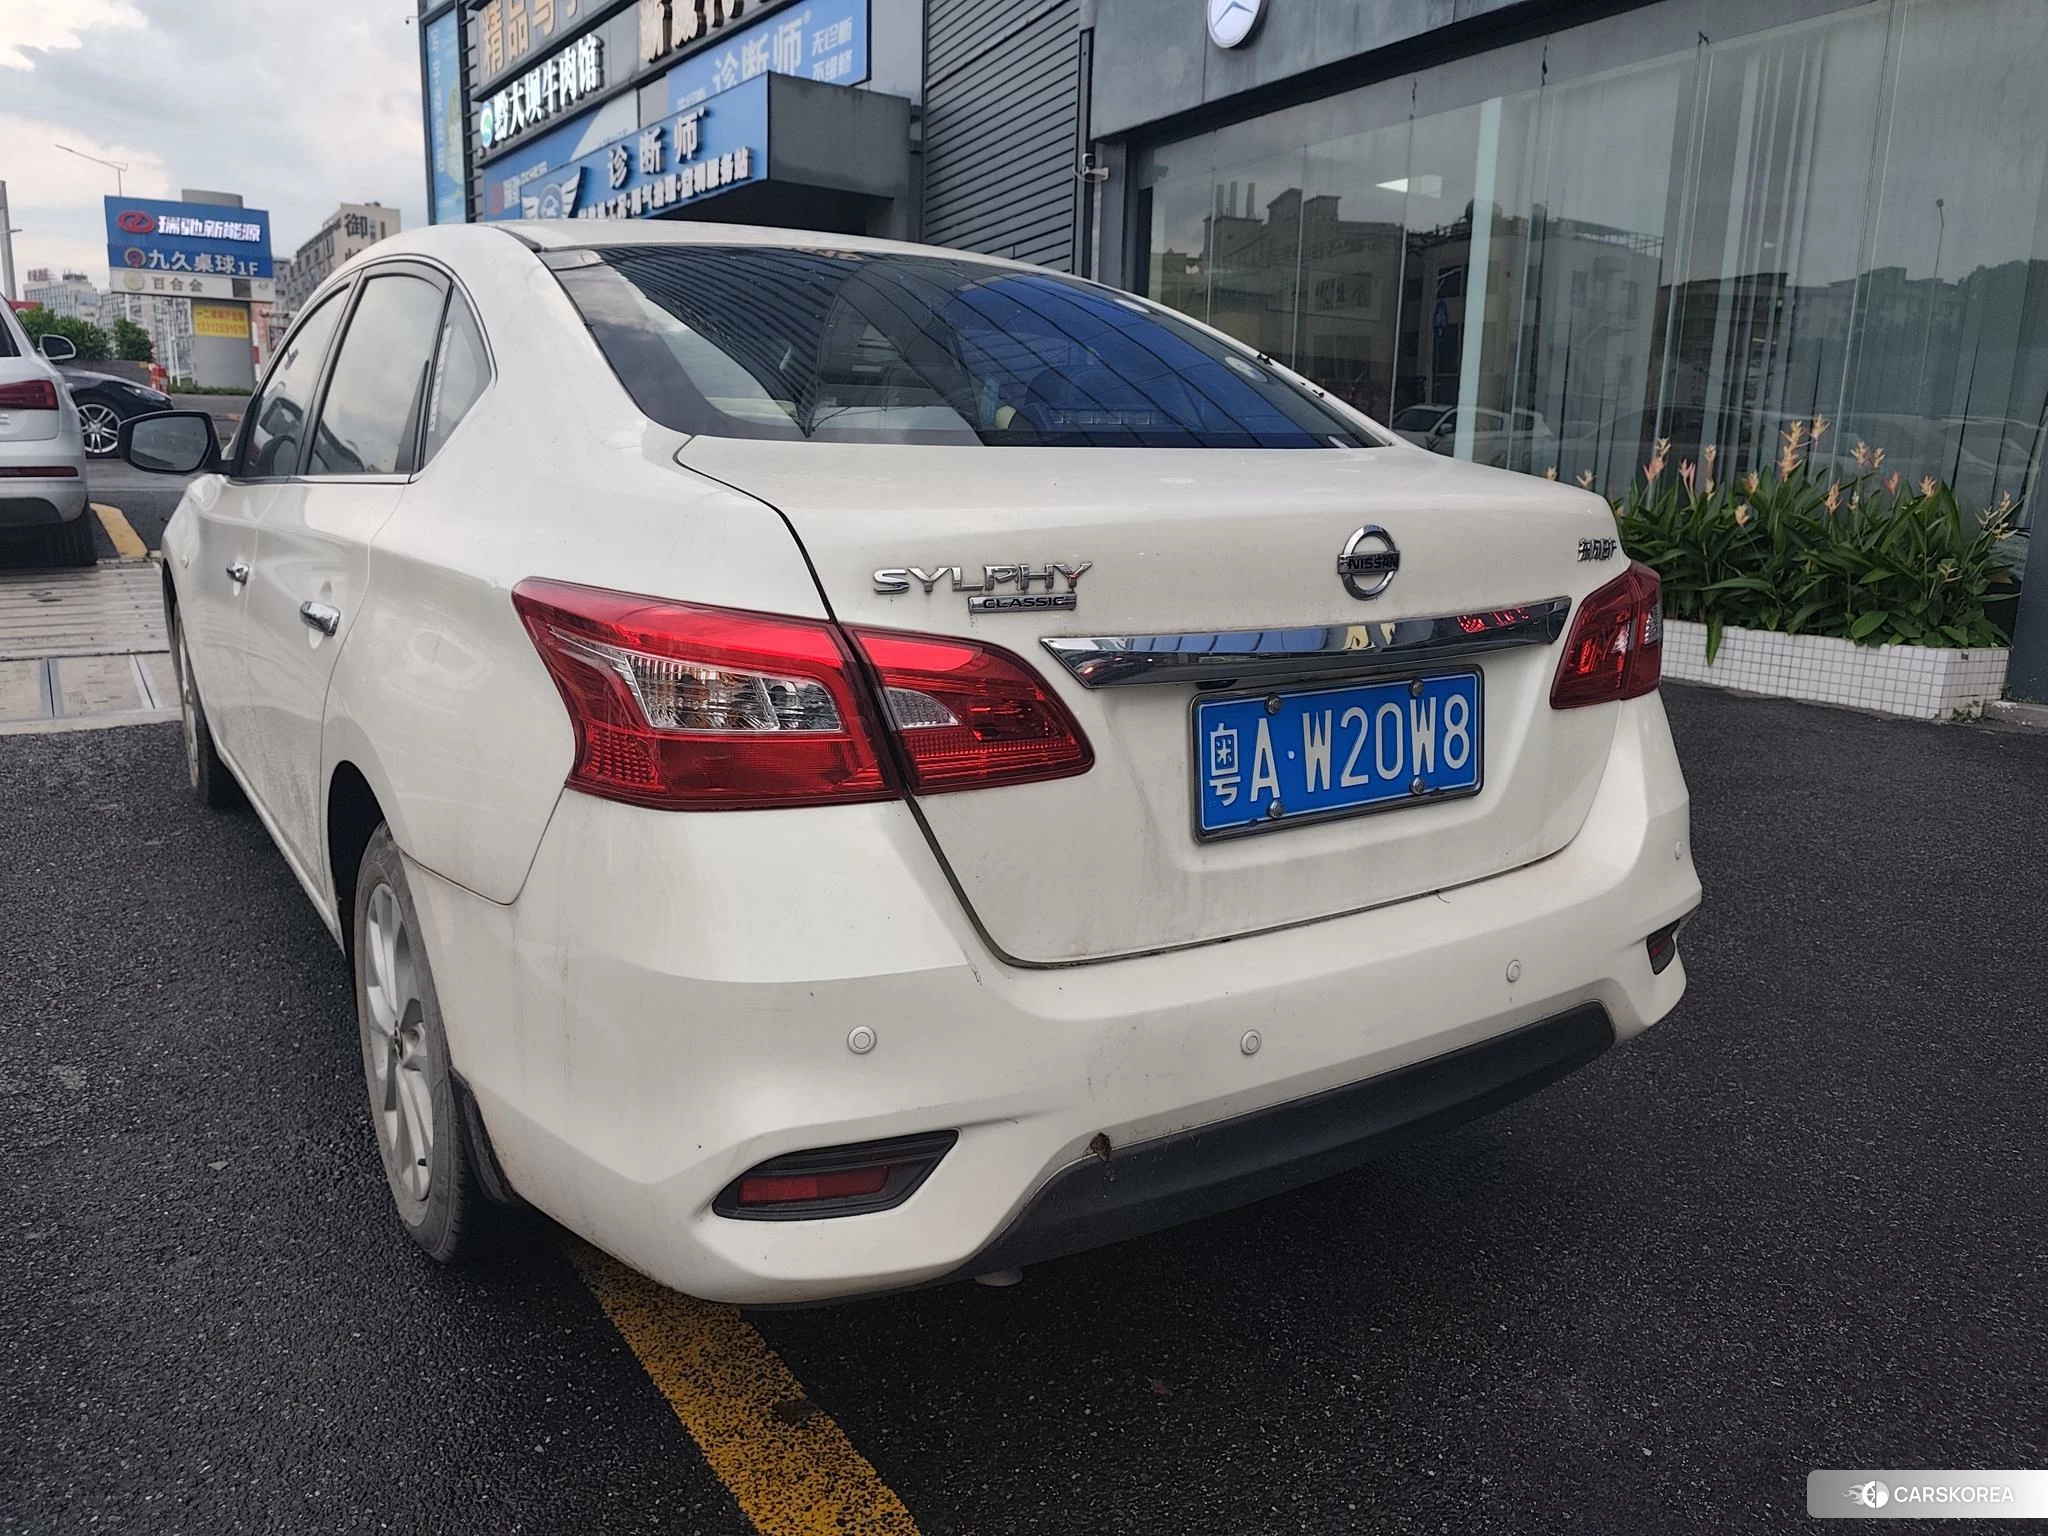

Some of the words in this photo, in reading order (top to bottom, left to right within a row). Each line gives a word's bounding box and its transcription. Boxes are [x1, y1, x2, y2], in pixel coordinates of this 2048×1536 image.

[608, 115, 698, 188] 诊断师
[158, 216, 261, 242] 瑞驰新能源
[148, 250, 236, 274] 九久桌球
[238, 261, 259, 275] 1F
[152, 276, 203, 292] 百合会
[1347, 556, 1399, 570] NISSAN
[873, 563, 1092, 595] SYLPHY
[983, 597, 1065, 609] CLASSIC
